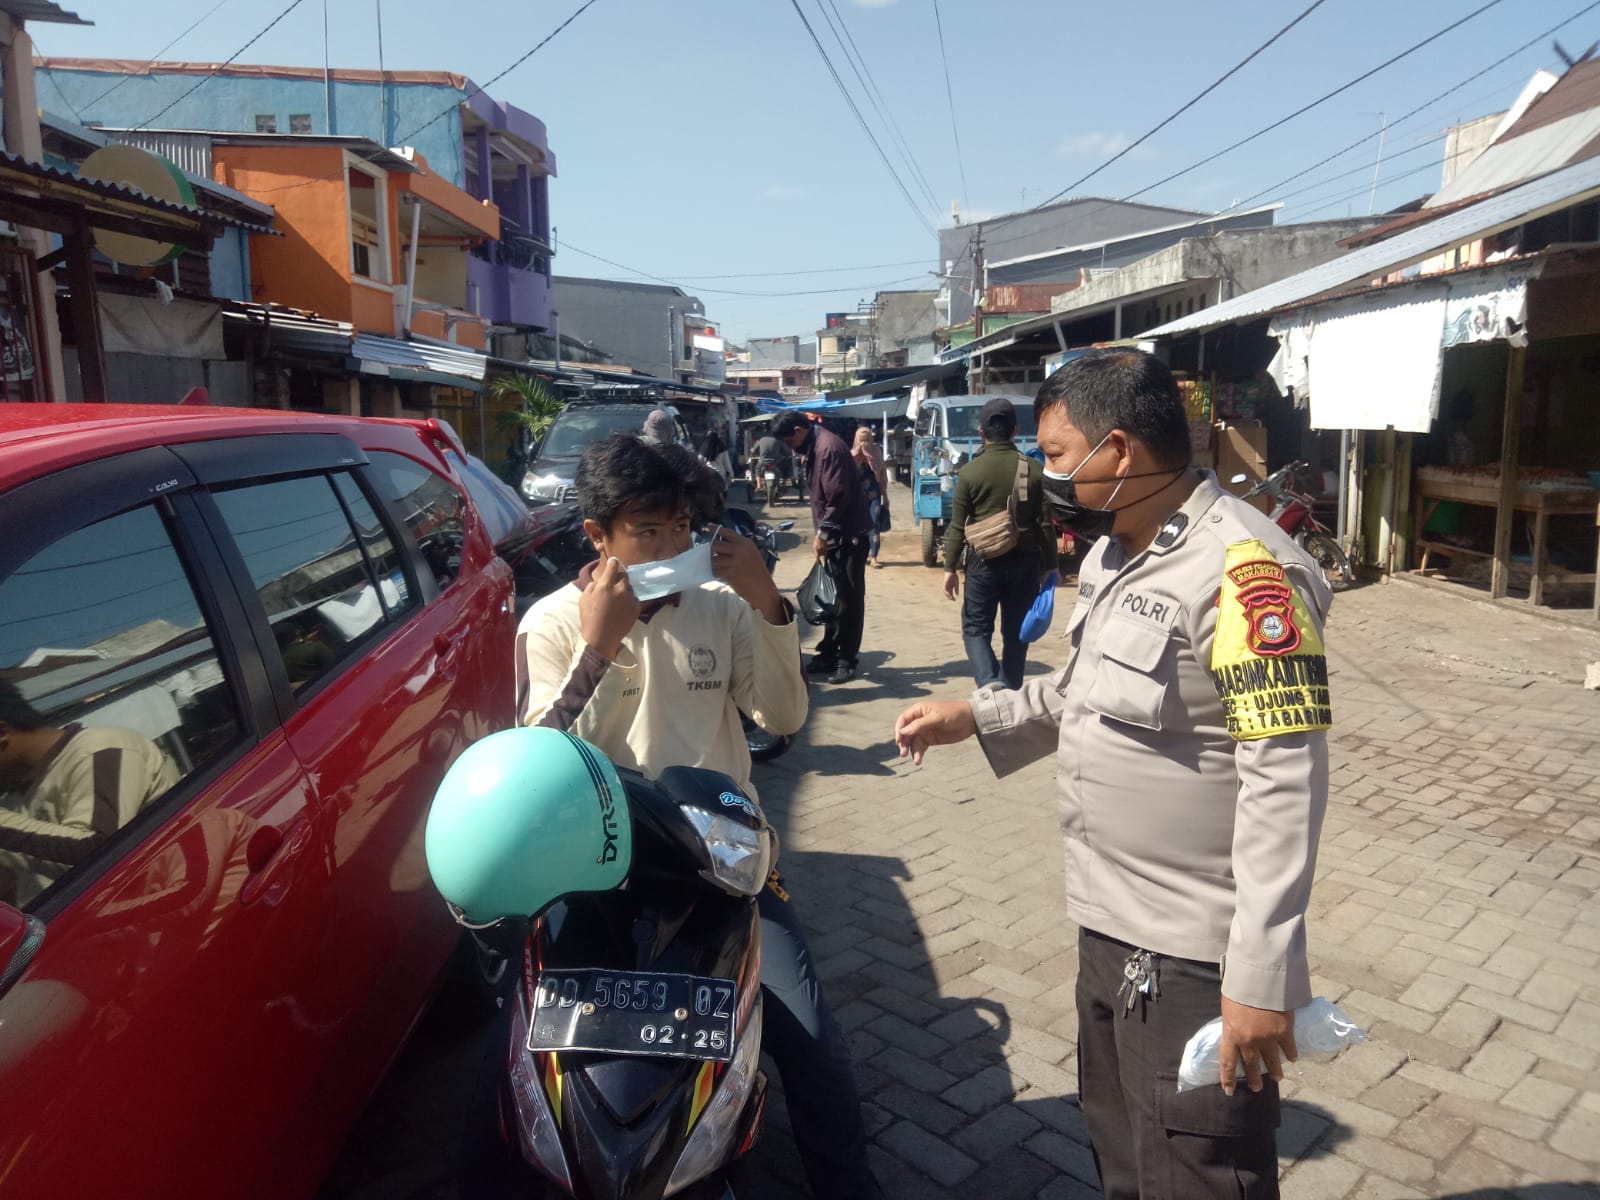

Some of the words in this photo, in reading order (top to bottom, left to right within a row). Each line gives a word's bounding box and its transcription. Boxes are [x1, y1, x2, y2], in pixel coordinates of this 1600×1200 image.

[1121, 593, 1170, 623] POLRI
[622, 687, 640, 698] FIRST
[687, 680, 722, 692] TKBM
[1254, 690, 1305, 711] UJUNG
[537, 977, 578, 1008] DD
[594, 976, 669, 1011] 5659
